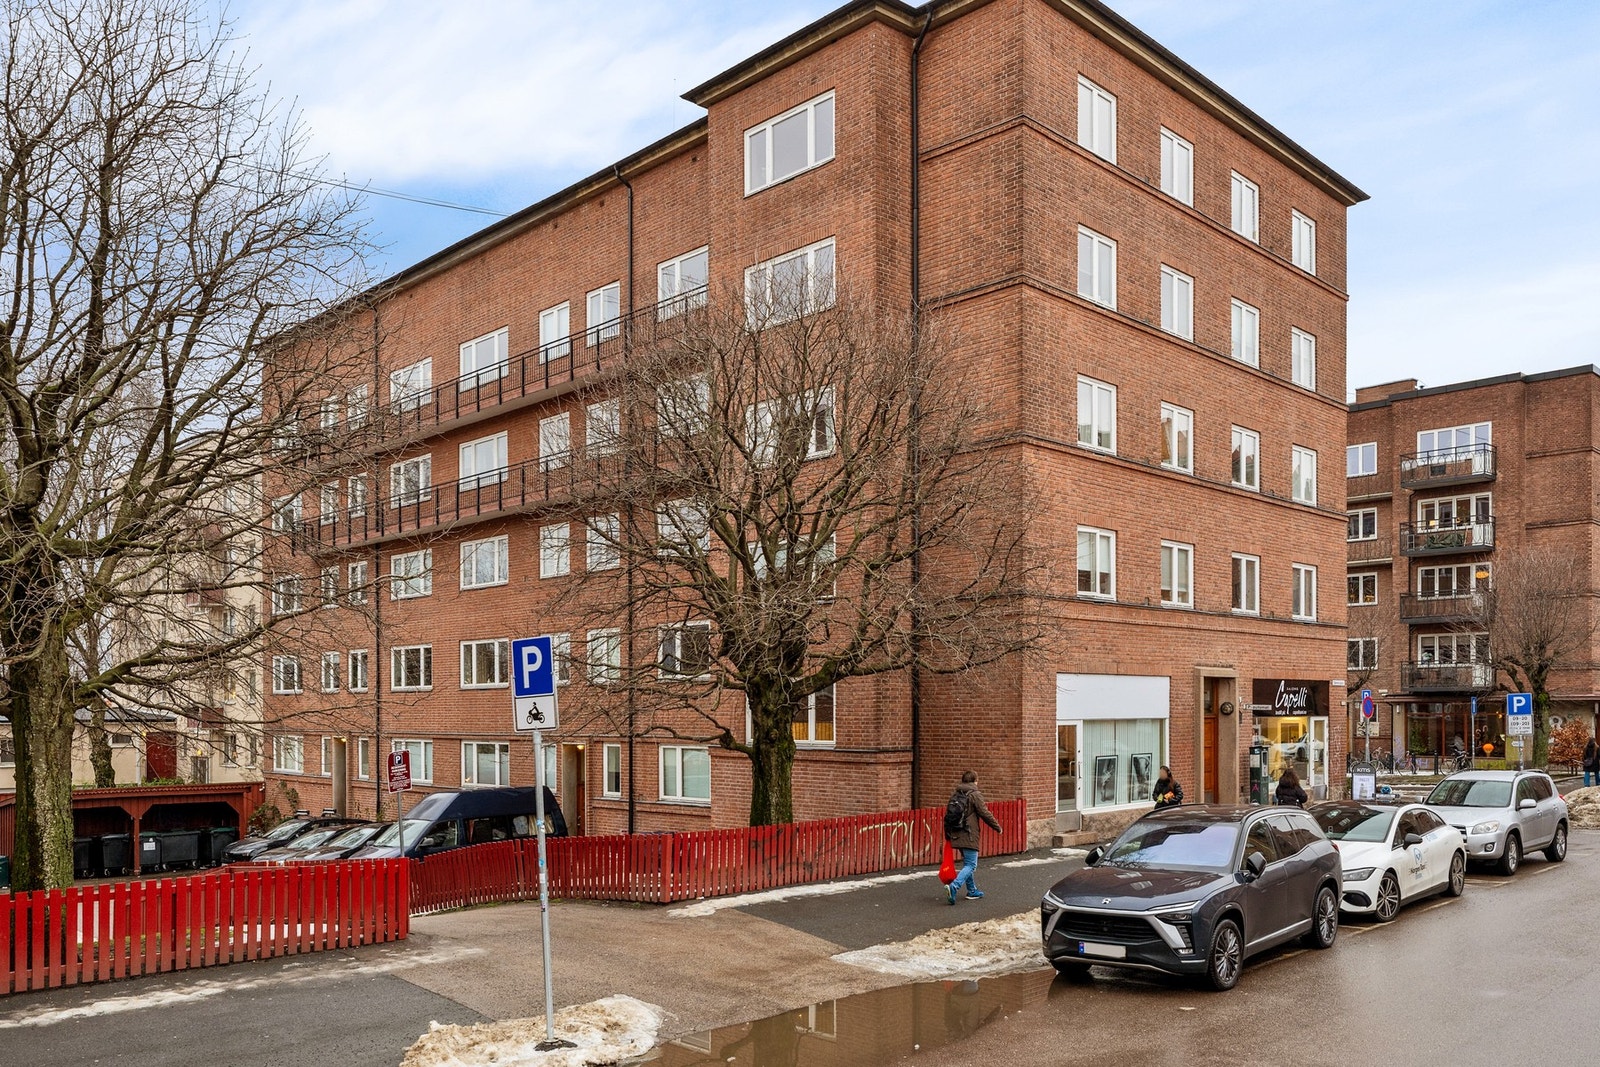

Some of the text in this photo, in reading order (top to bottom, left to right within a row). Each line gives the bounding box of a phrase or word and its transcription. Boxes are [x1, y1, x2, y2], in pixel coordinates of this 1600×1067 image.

[521, 645, 543, 689] P
[1275, 680, 1308, 715] Capelli
[1513, 696, 1526, 713] P
[395, 755, 402, 765] P
